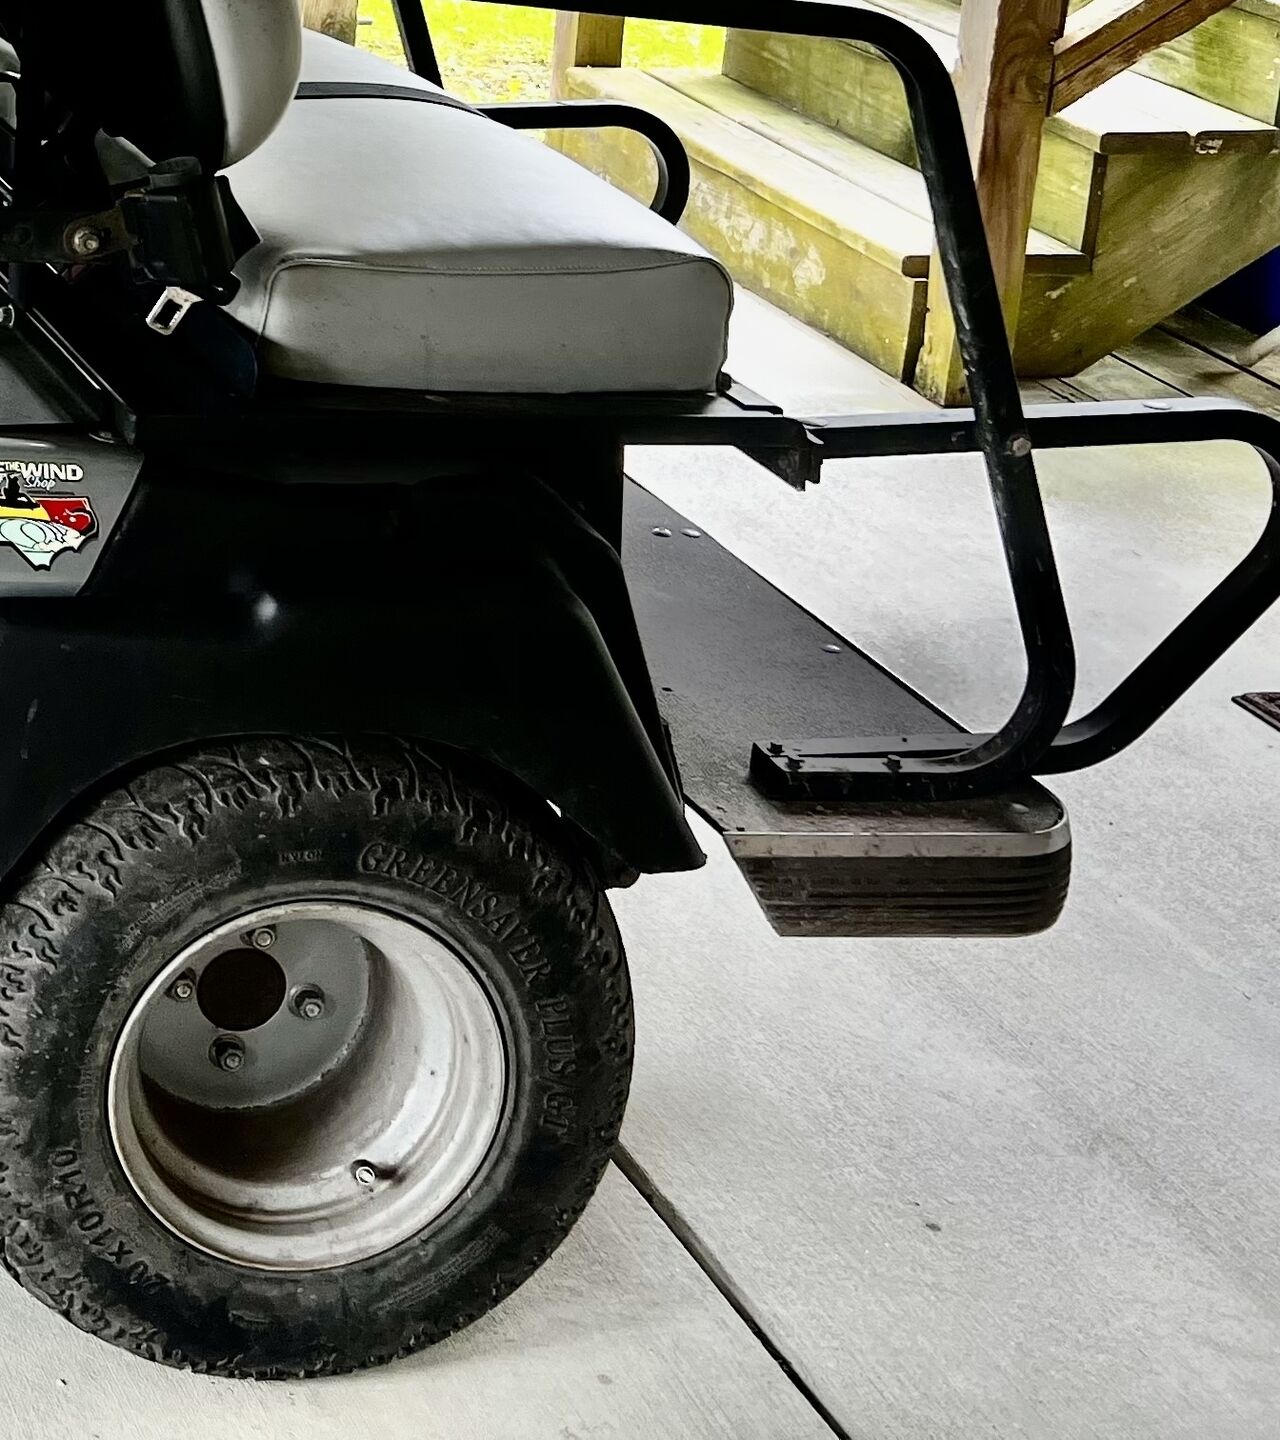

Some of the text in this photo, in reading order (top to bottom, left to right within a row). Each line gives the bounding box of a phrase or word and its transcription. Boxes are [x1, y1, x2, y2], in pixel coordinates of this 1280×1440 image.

[5, 461, 21, 471] THE
[20, 462, 84, 481] WIND
[24, 474, 56, 491] Shop
[359, 841, 578, 1131] GREENSAVER PLUS/GT
